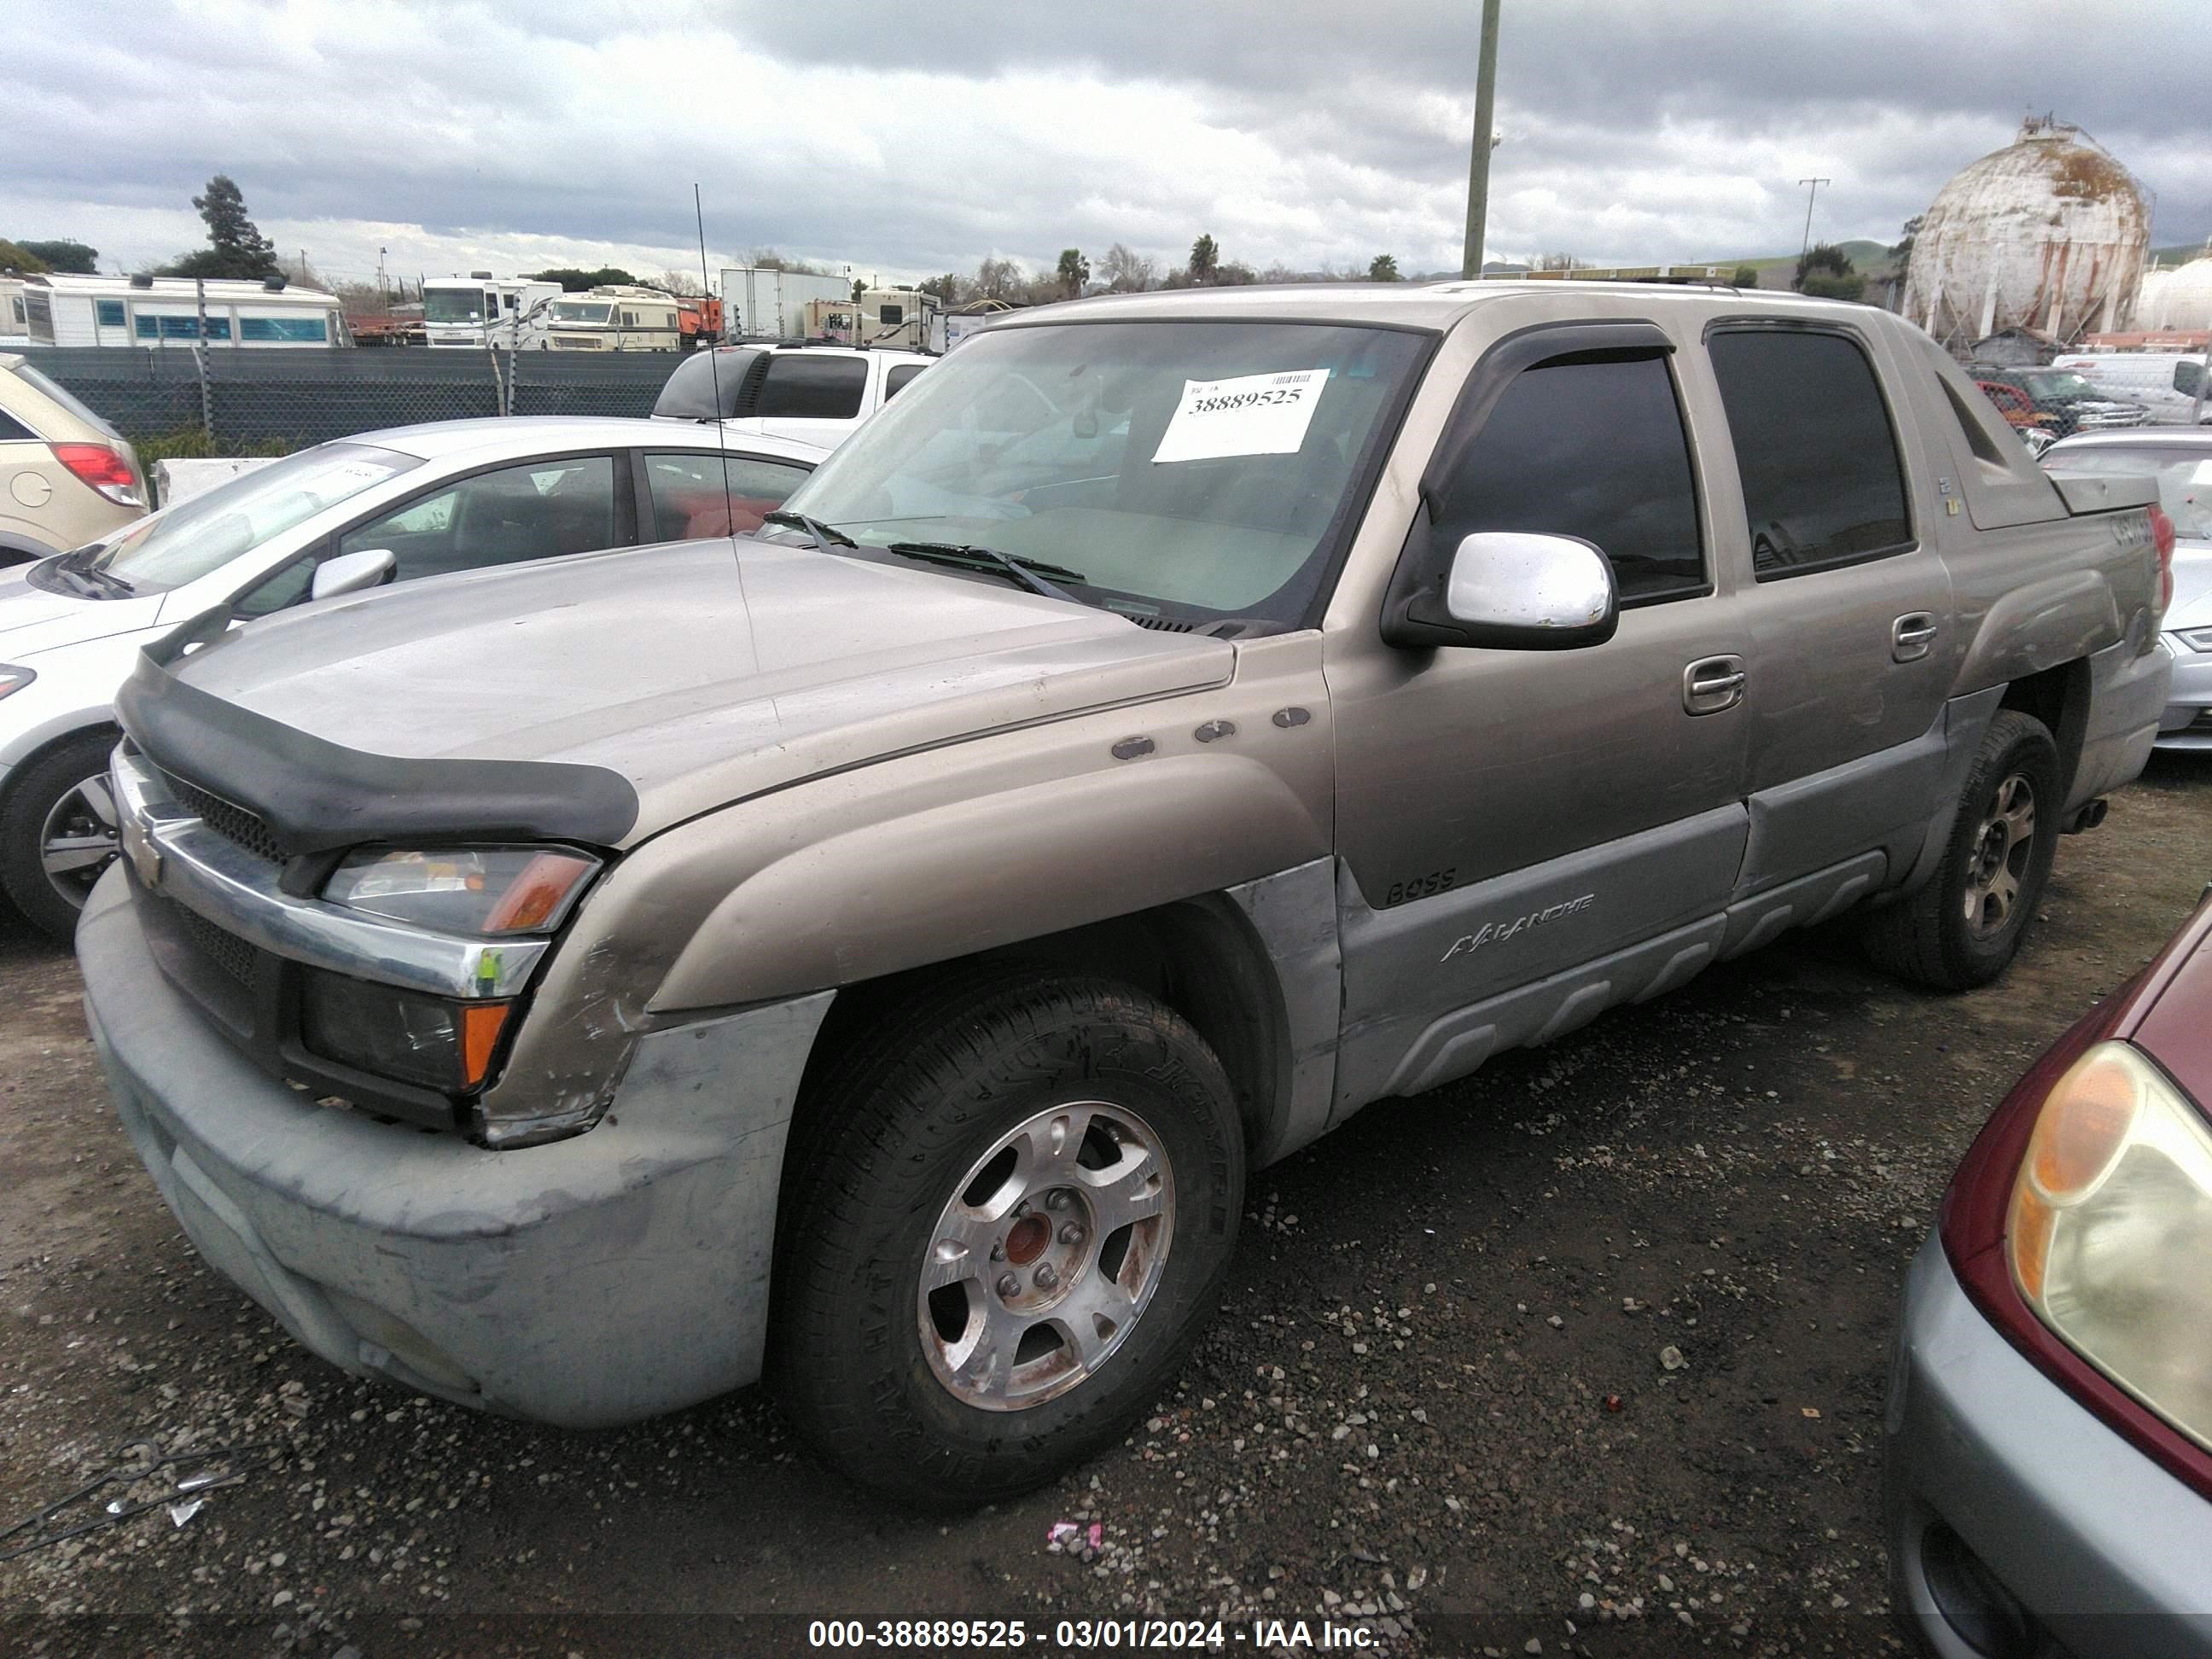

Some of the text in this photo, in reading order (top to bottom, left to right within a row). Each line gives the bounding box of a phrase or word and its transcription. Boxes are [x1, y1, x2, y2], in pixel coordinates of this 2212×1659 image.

[1188, 388, 1303, 415] 38889525
[1386, 867, 1456, 905] BOSS
[1441, 894, 1595, 963] AVALANCHE
